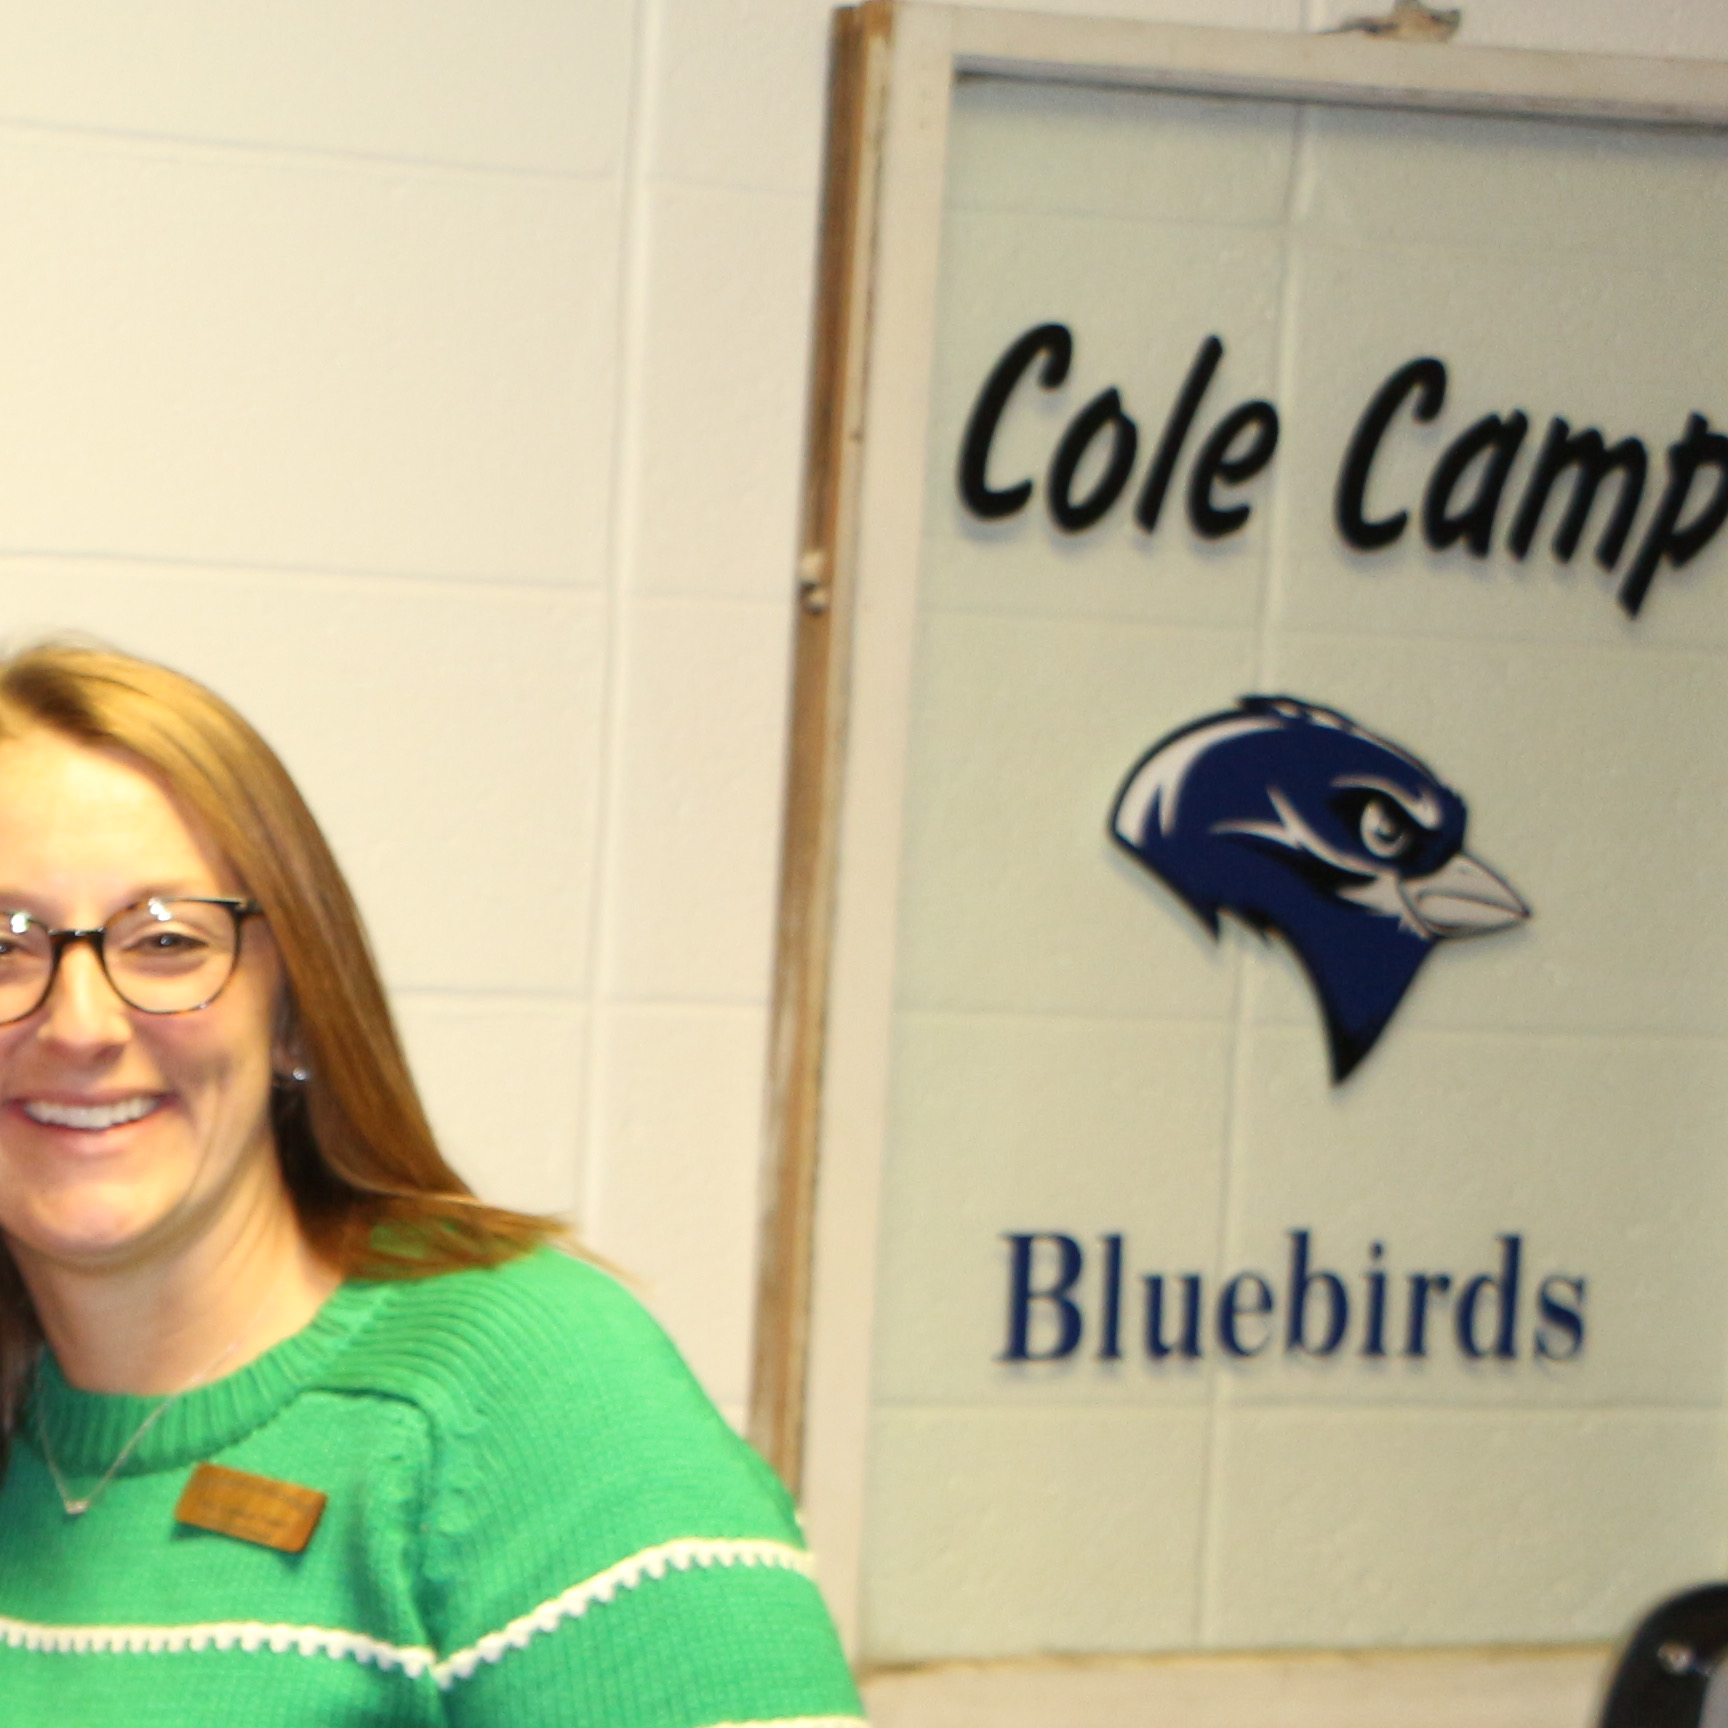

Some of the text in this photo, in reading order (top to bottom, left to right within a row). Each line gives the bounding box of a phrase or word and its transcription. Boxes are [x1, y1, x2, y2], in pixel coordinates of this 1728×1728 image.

[957, 322, 1728, 619] Cole Camp
[999, 1228, 1588, 1366] Bluebirds
